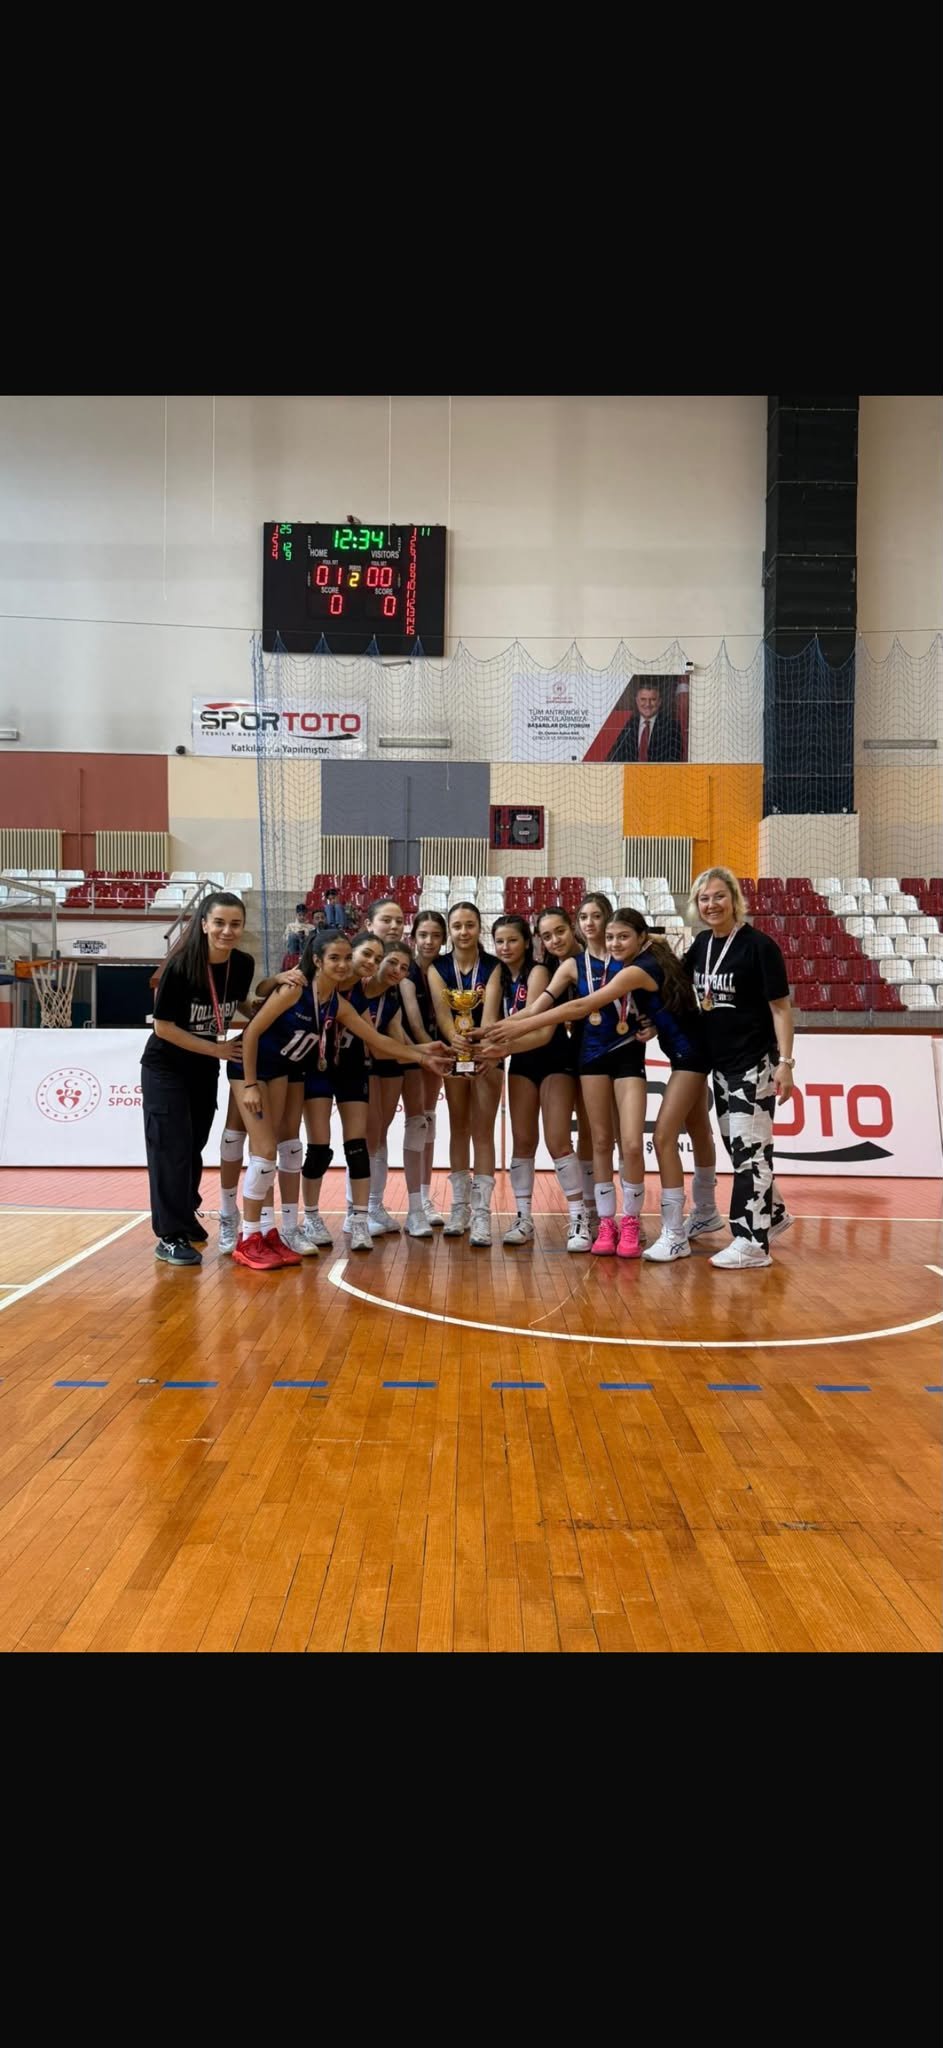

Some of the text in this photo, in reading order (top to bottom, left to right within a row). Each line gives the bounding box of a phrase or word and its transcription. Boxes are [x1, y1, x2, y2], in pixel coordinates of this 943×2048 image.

[280, 524, 292, 534] 25
[334, 529, 384, 550] 12:34
[309, 549, 328, 557] HOME
[371, 551, 400, 559] VISITORS
[316, 565, 343, 585] 01
[349, 572, 360, 587] 2
[366, 566, 392, 587] 00
[330, 594, 343, 615] 0
[383, 595, 396, 616] 0
[231, 743, 279, 753] Katkılarıa
[189, 1001, 239, 1023] VOLLYBA
[280, 1029, 320, 1062] 10
[109, 1085, 131, 1094] T.C.
[108, 1097, 142, 1107] SPOR
